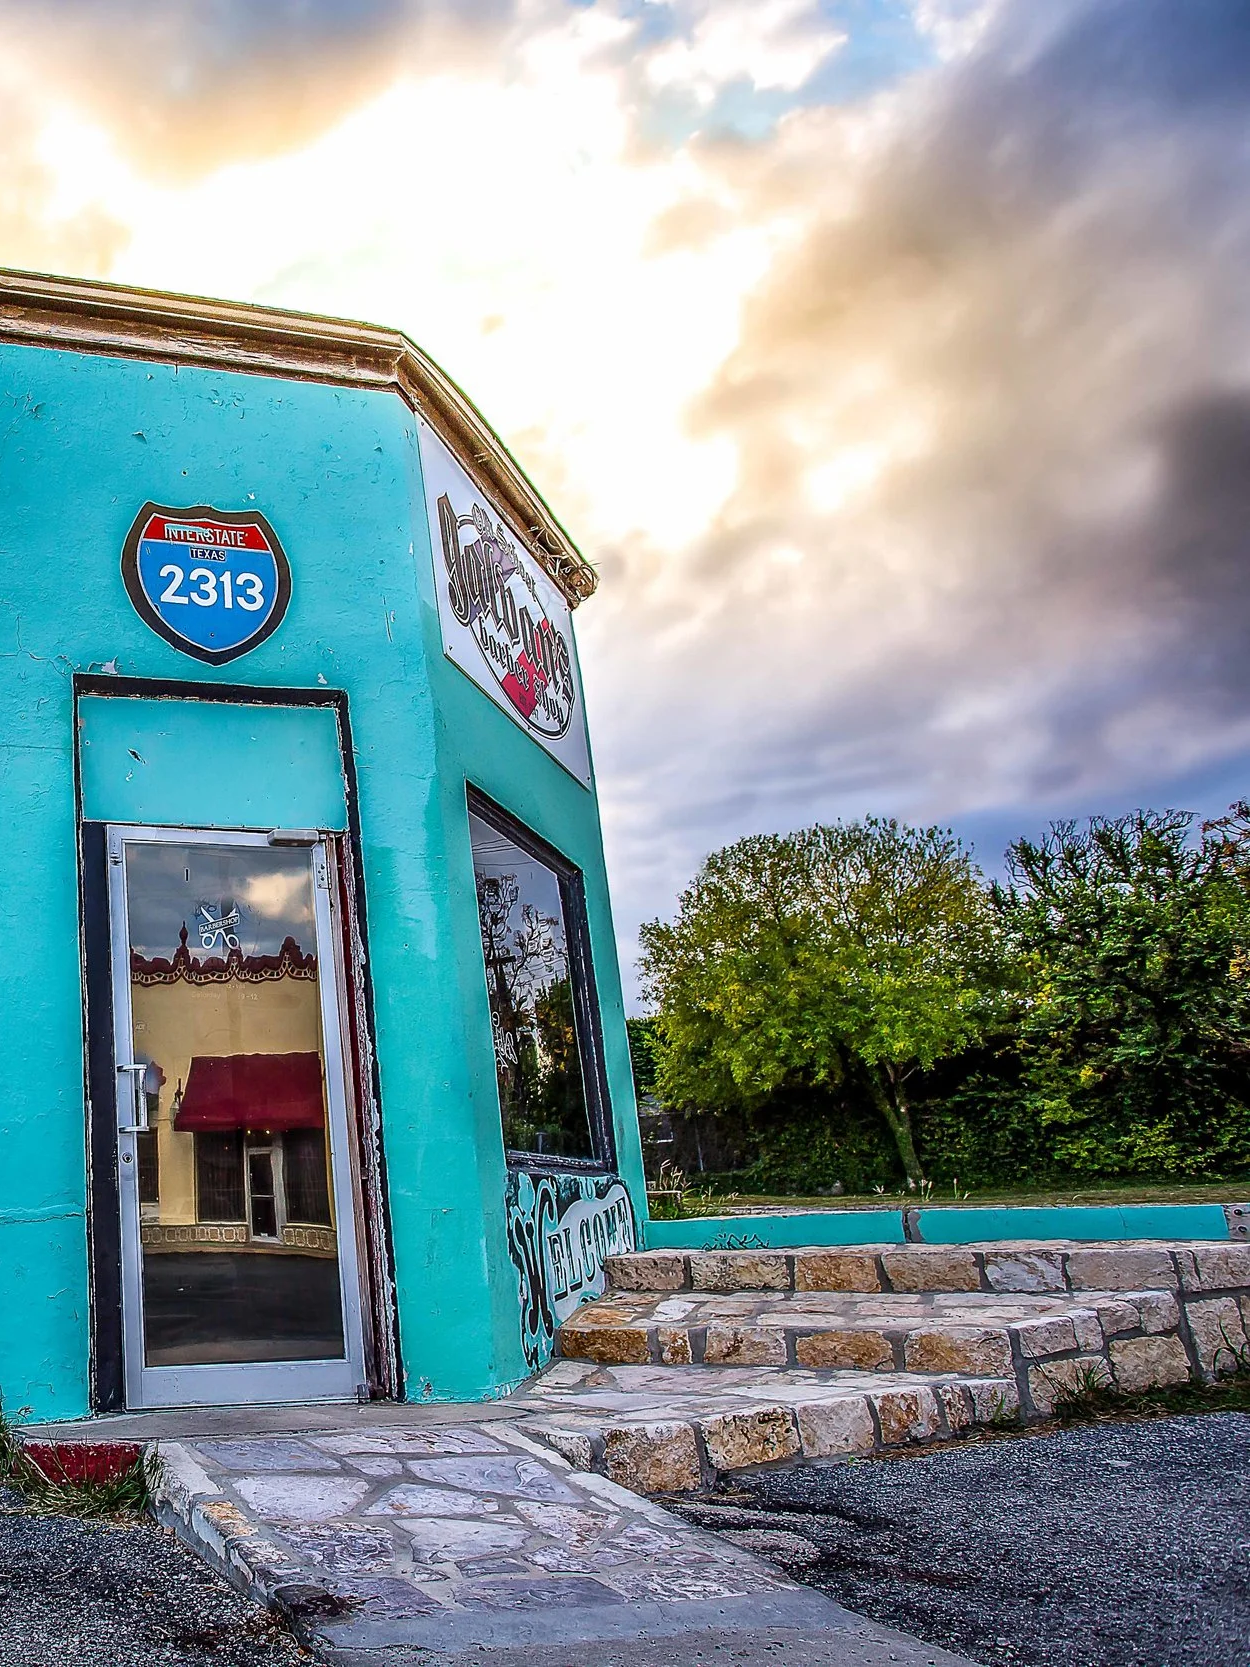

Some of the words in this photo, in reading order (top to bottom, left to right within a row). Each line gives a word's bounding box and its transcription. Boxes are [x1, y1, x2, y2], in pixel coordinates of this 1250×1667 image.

[164, 525, 246, 546] INTERSTATE
[191, 549, 225, 561] TEXAS
[159, 564, 264, 611] 2313
[200, 917, 238, 932] BARBERSHOP
